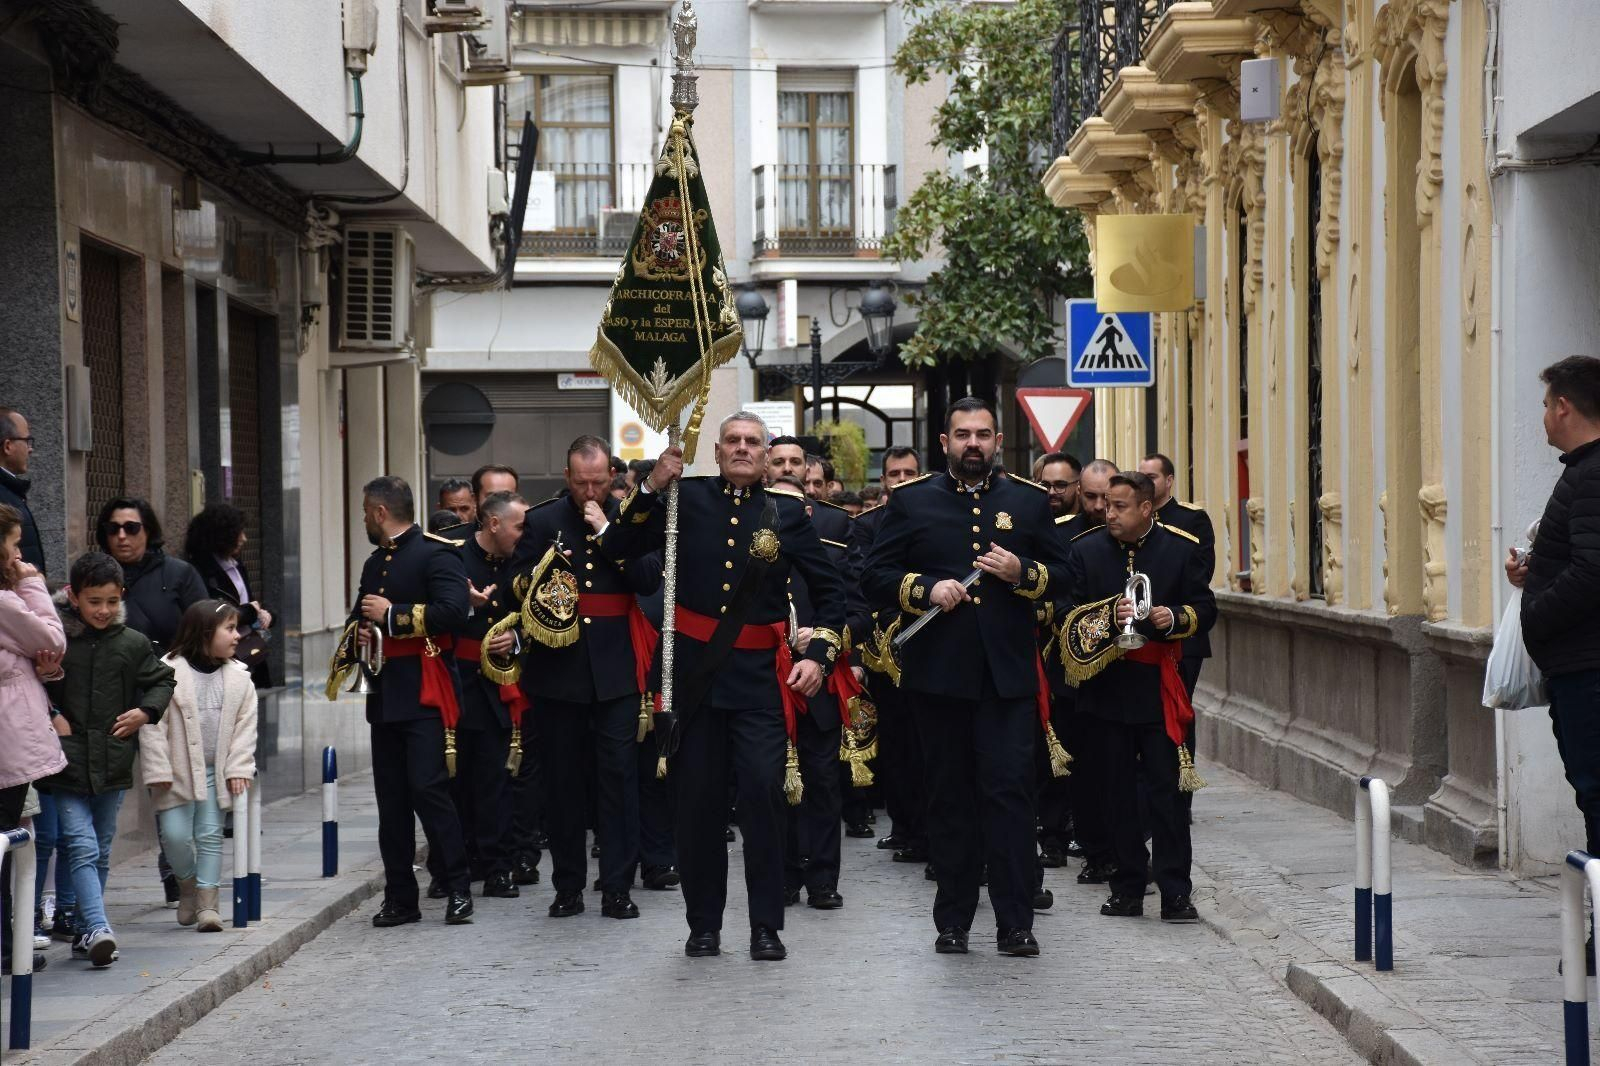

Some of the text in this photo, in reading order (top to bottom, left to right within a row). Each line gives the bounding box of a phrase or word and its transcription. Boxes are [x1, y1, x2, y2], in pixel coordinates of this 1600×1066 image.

[654, 303, 671, 313] del
[605, 317, 629, 327] ASO
[631, 319, 638, 329] y
[641, 318, 651, 327] la
[531, 600, 562, 627] ESPERANZA
